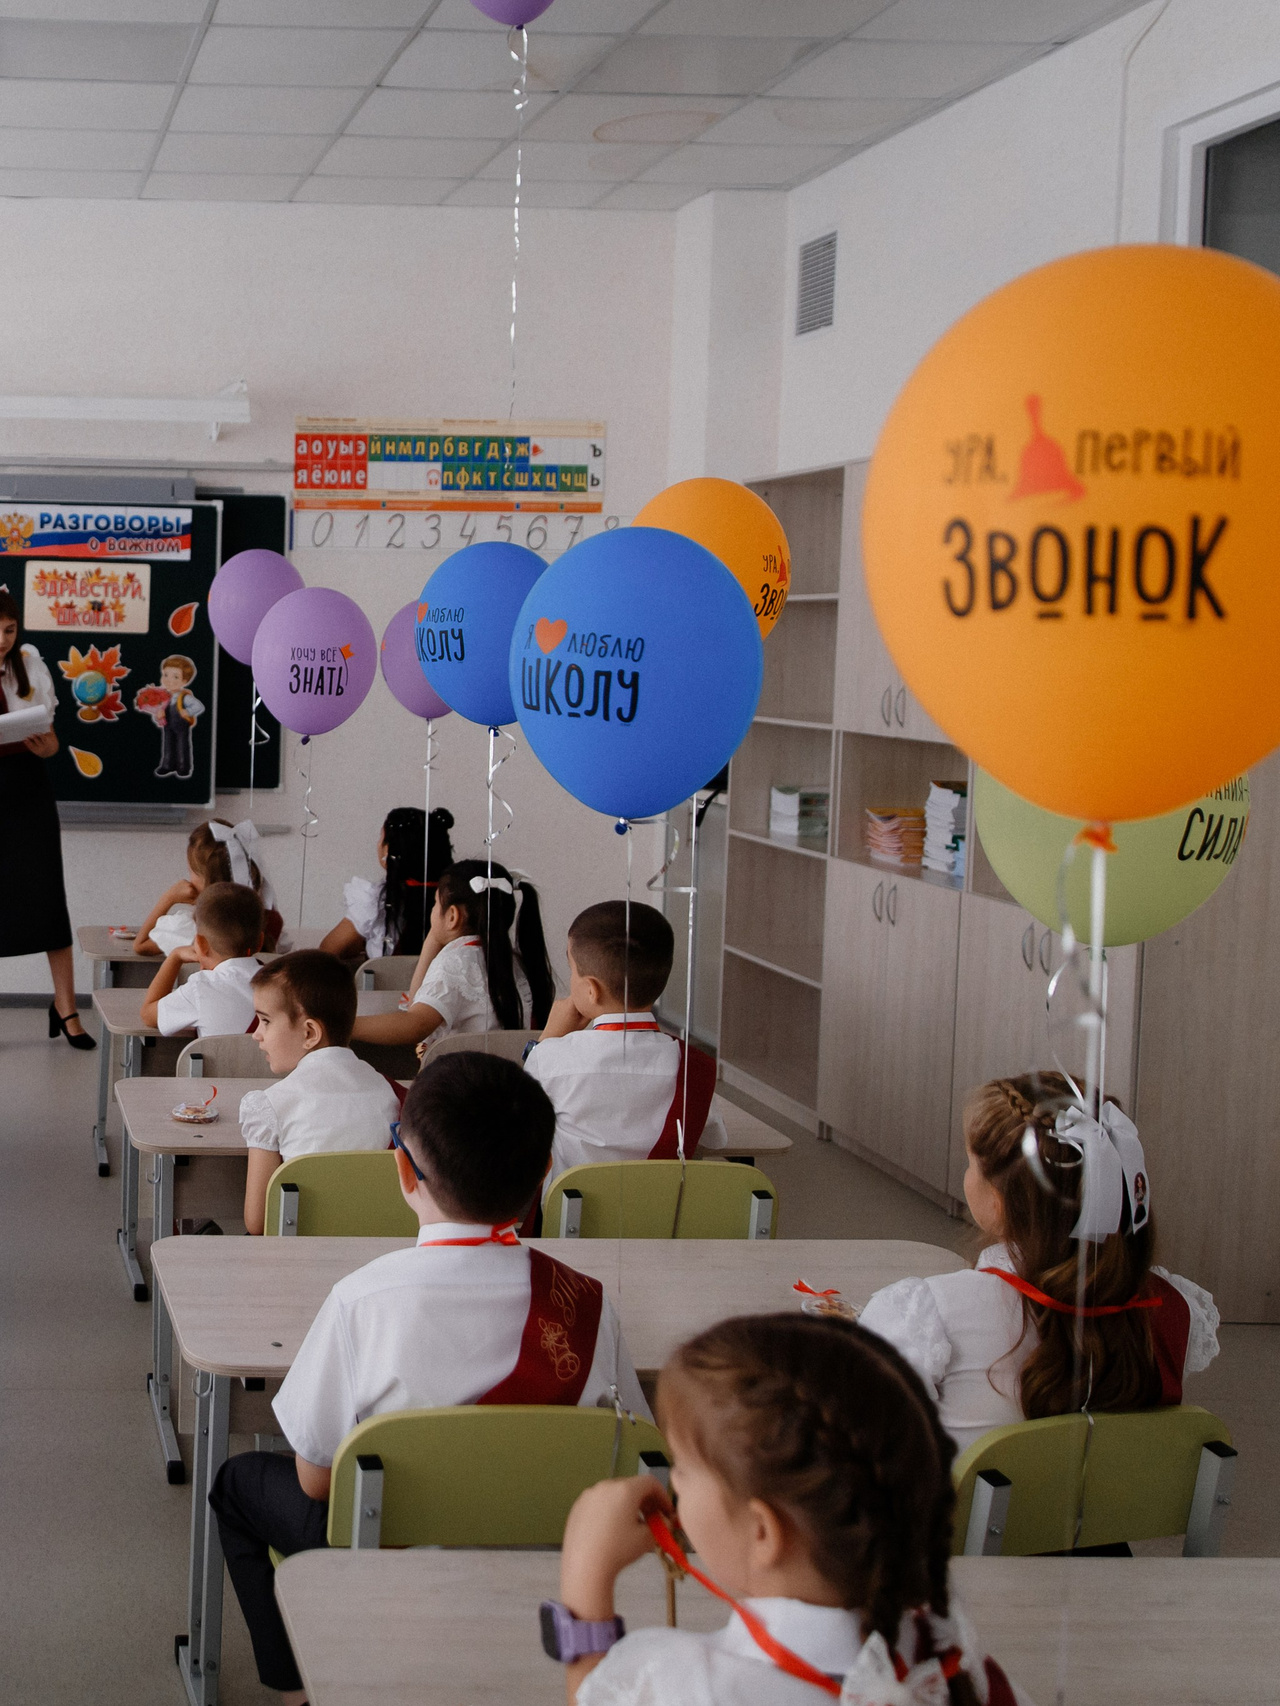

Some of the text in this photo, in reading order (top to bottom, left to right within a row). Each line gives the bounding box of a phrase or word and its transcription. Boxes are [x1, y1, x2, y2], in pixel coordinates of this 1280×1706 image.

[39, 512, 182, 533] РАЗГОВОРЫ
[942, 514, 1230, 622] ЗВОНОК
[524, 624, 535, 650] Я
[291, 647, 316, 662] ХОЧУ
[289, 664, 344, 696] ЗНАТЬ
[522, 657, 640, 723] ШКОЛУ
[1178, 807, 1245, 865] СИЛА
